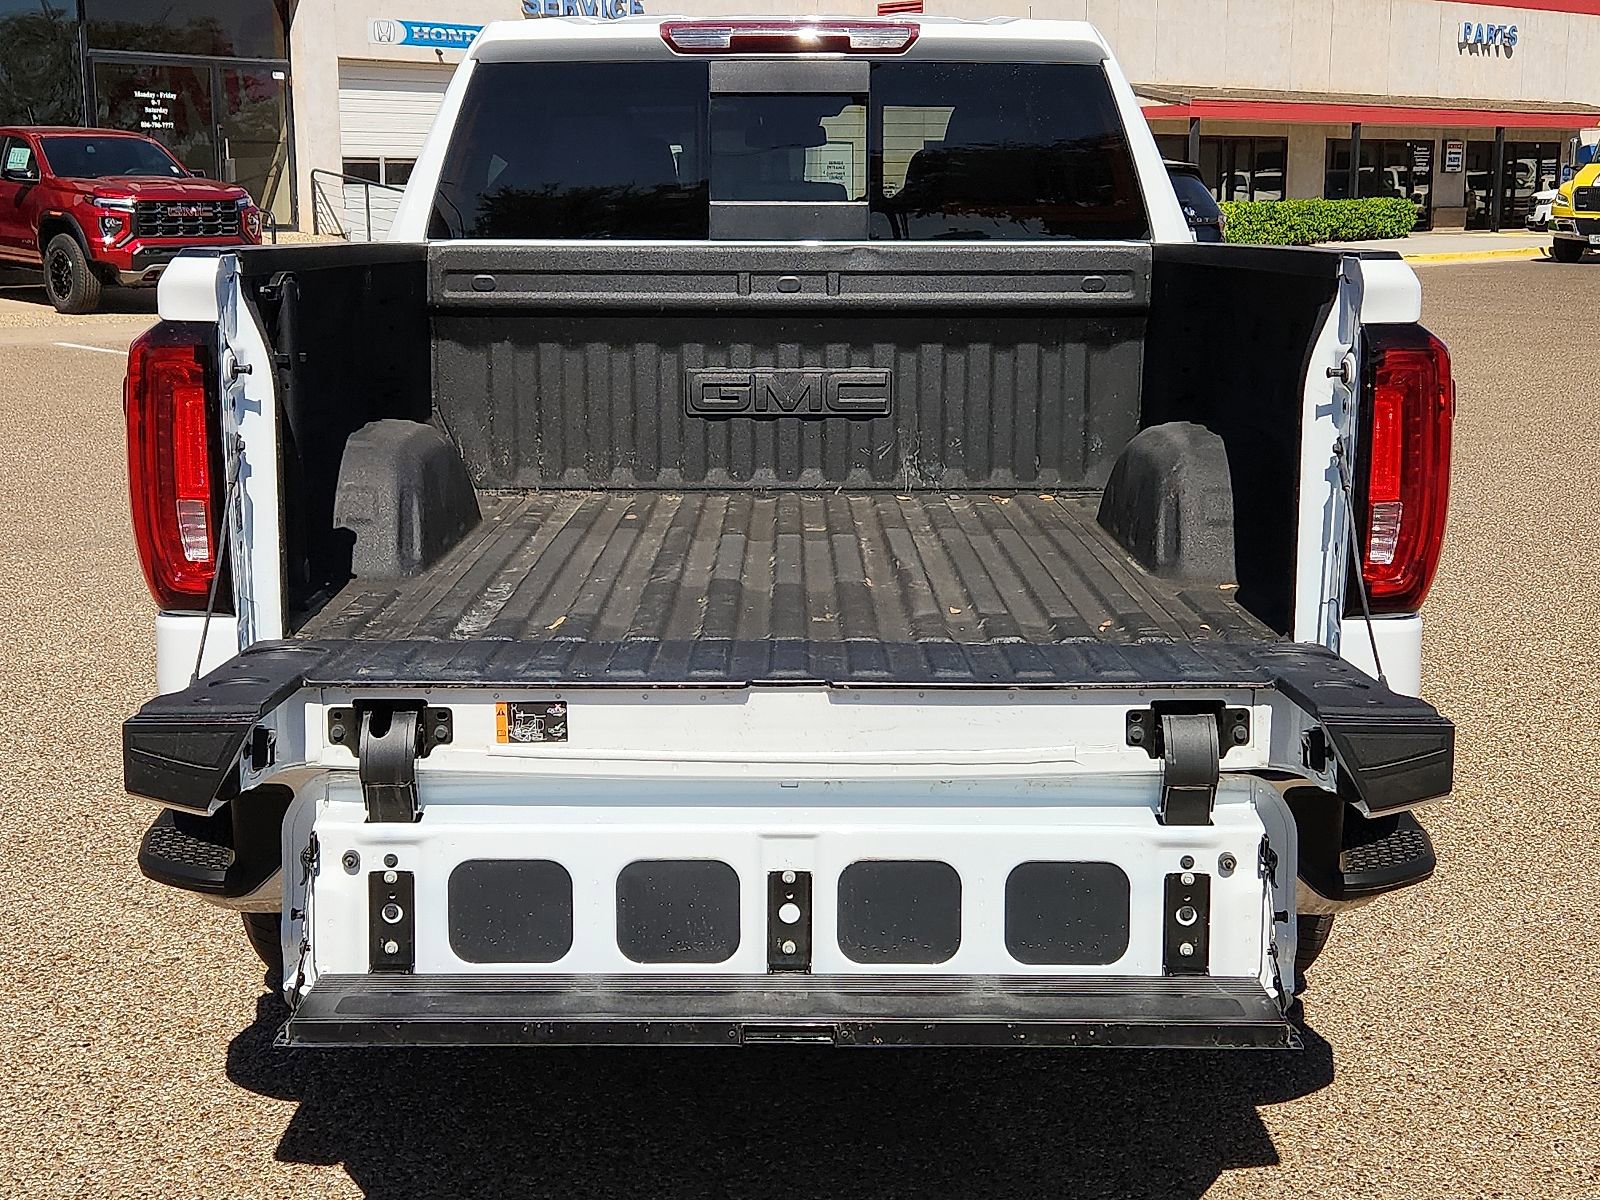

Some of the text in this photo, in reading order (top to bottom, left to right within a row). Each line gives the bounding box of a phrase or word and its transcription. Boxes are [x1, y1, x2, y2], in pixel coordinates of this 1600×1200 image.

[411, 26, 479, 43] HOND
[1464, 22, 1518, 46] PARTS
[134, 91, 155, 99] Monday
[160, 92, 177, 100] Friday
[144, 106, 168, 115] Saturday
[167, 207, 213, 217] GMC
[690, 373, 888, 413] GMC
